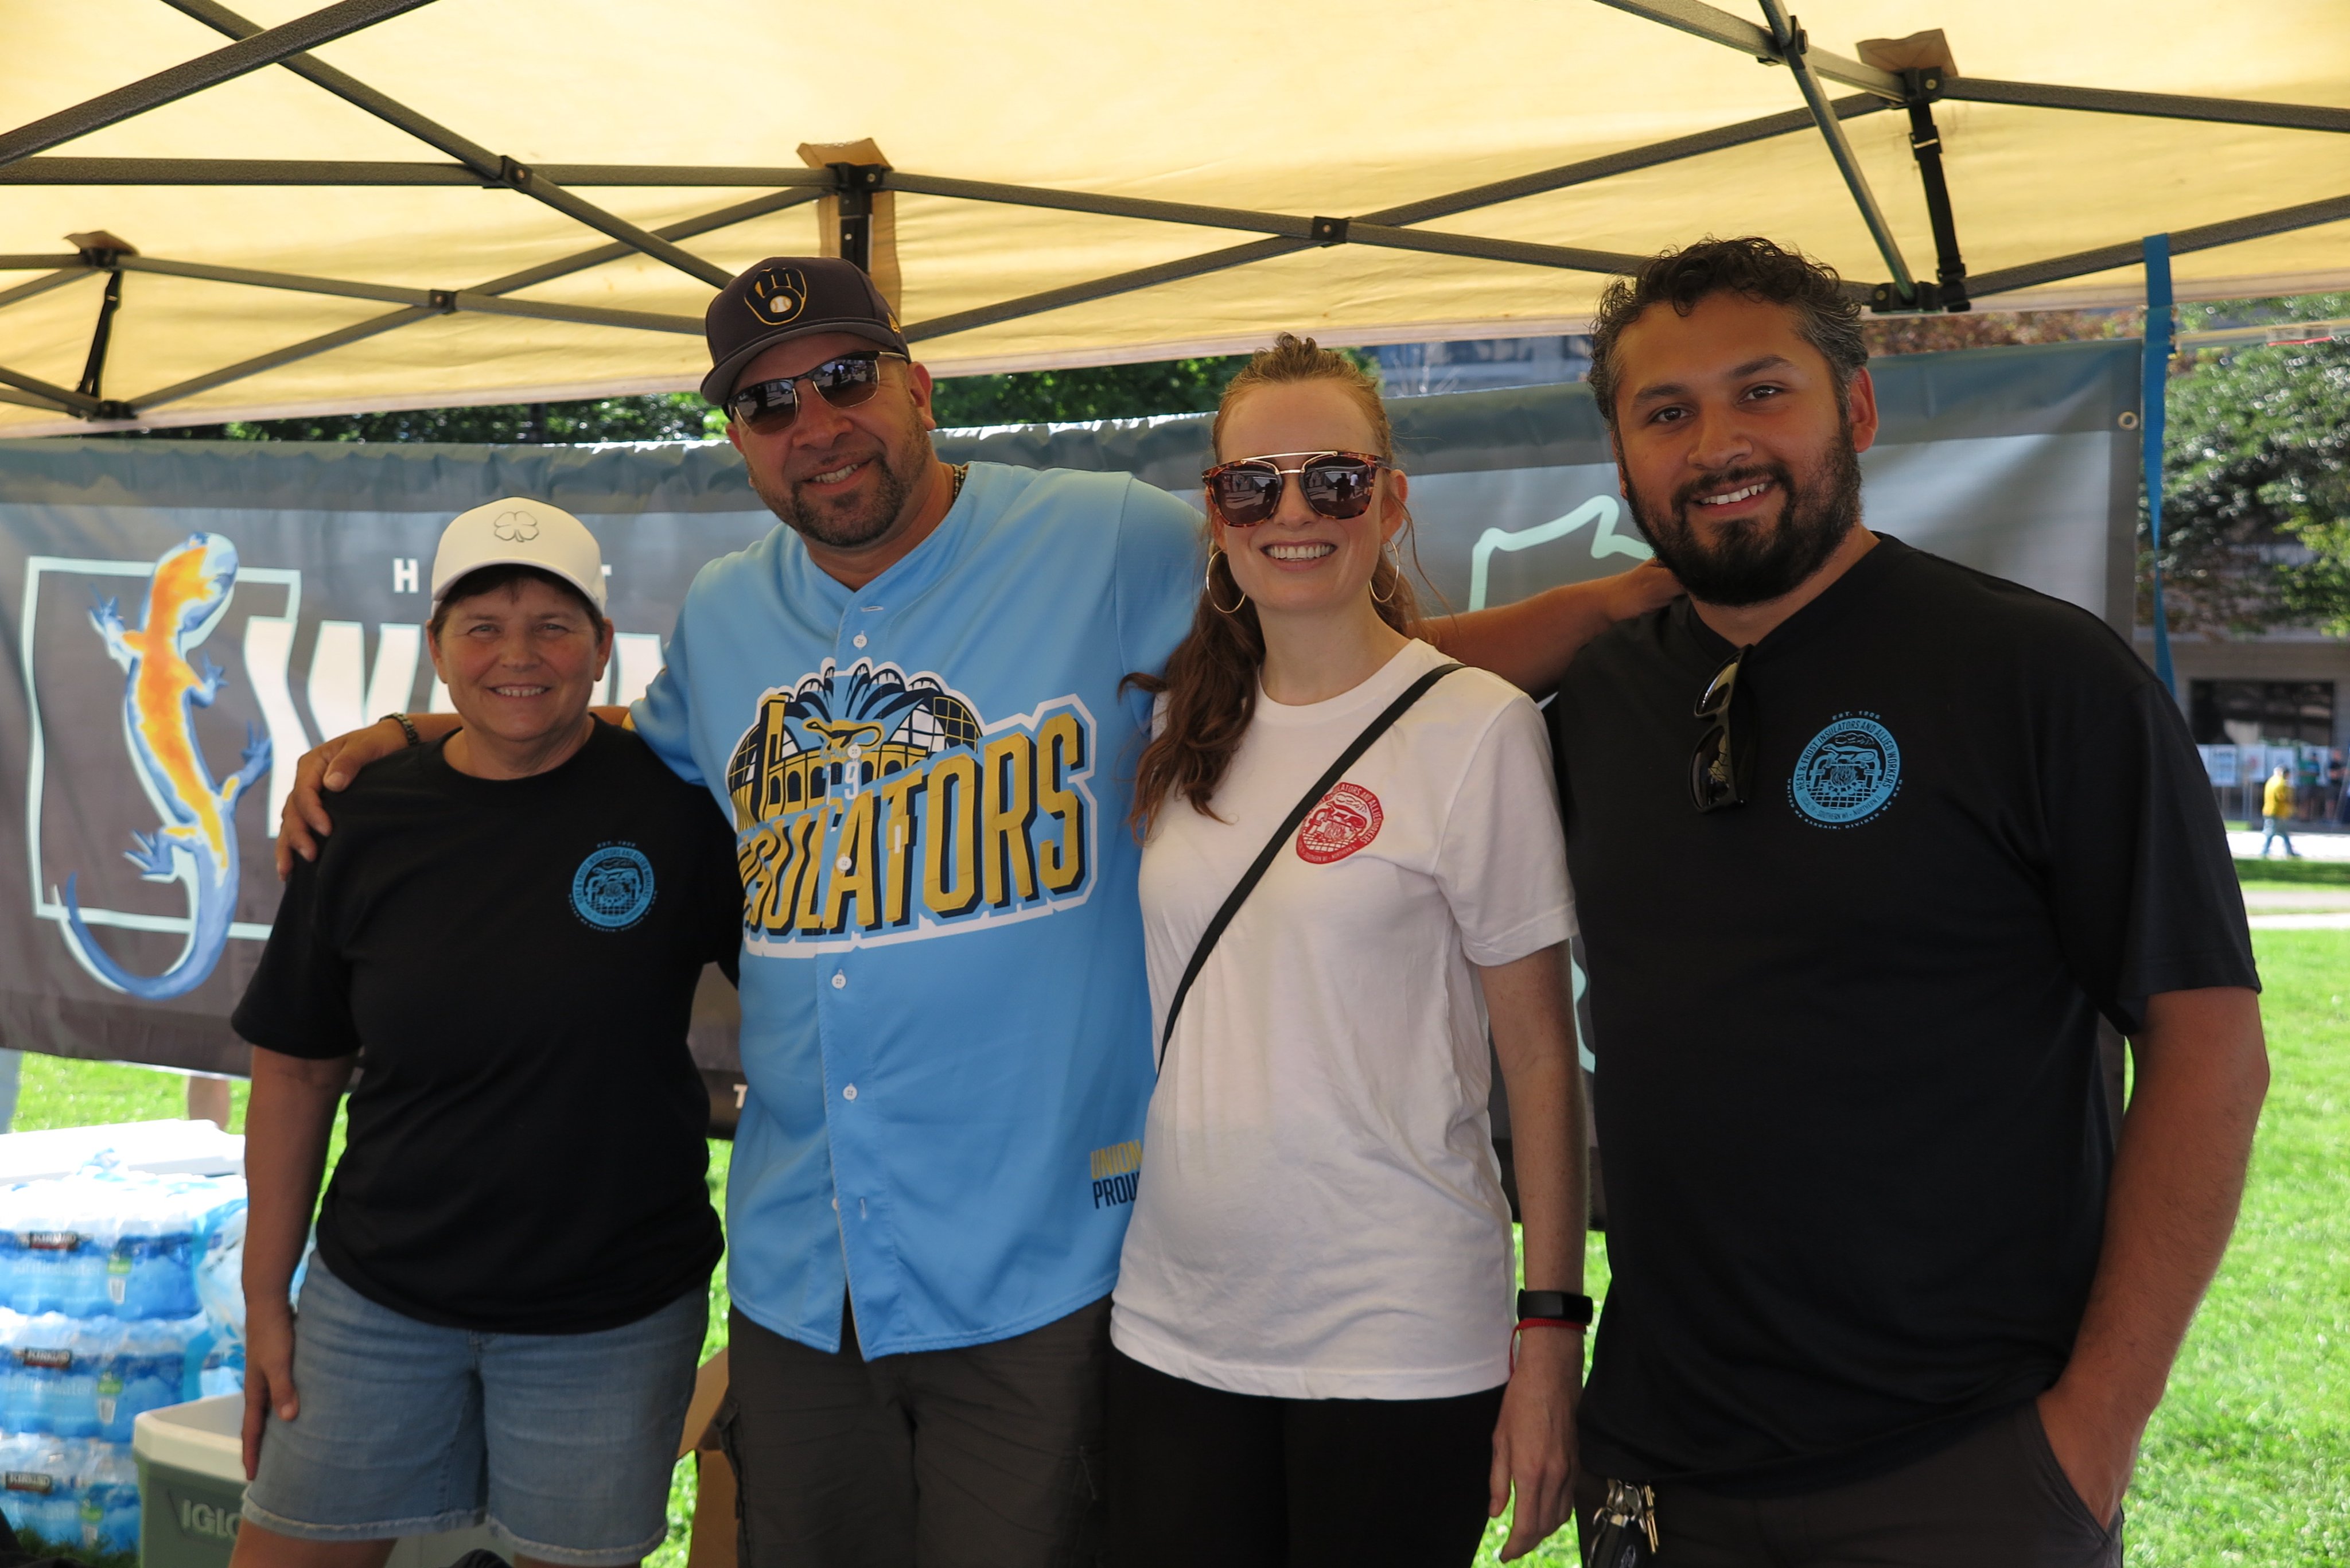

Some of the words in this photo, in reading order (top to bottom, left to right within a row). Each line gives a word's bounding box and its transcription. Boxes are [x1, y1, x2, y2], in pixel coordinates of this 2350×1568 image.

[1832, 711, 1853, 721] EST.
[1819, 720, 1859, 744] INSULATORS
[1861, 721, 1876, 733] AND
[1873, 729, 1894, 752] ALLIED
[1803, 743, 1818, 764] FROST
[1882, 752, 1897, 789] WORKERS
[1796, 773, 1805, 791] HEAT
[1853, 799, 1878, 816] NORTHERN
[1845, 813, 1880, 829] DIVIDED
[1091, 1139, 1142, 1180] UNION
[1092, 1171, 1140, 1209] PROU
